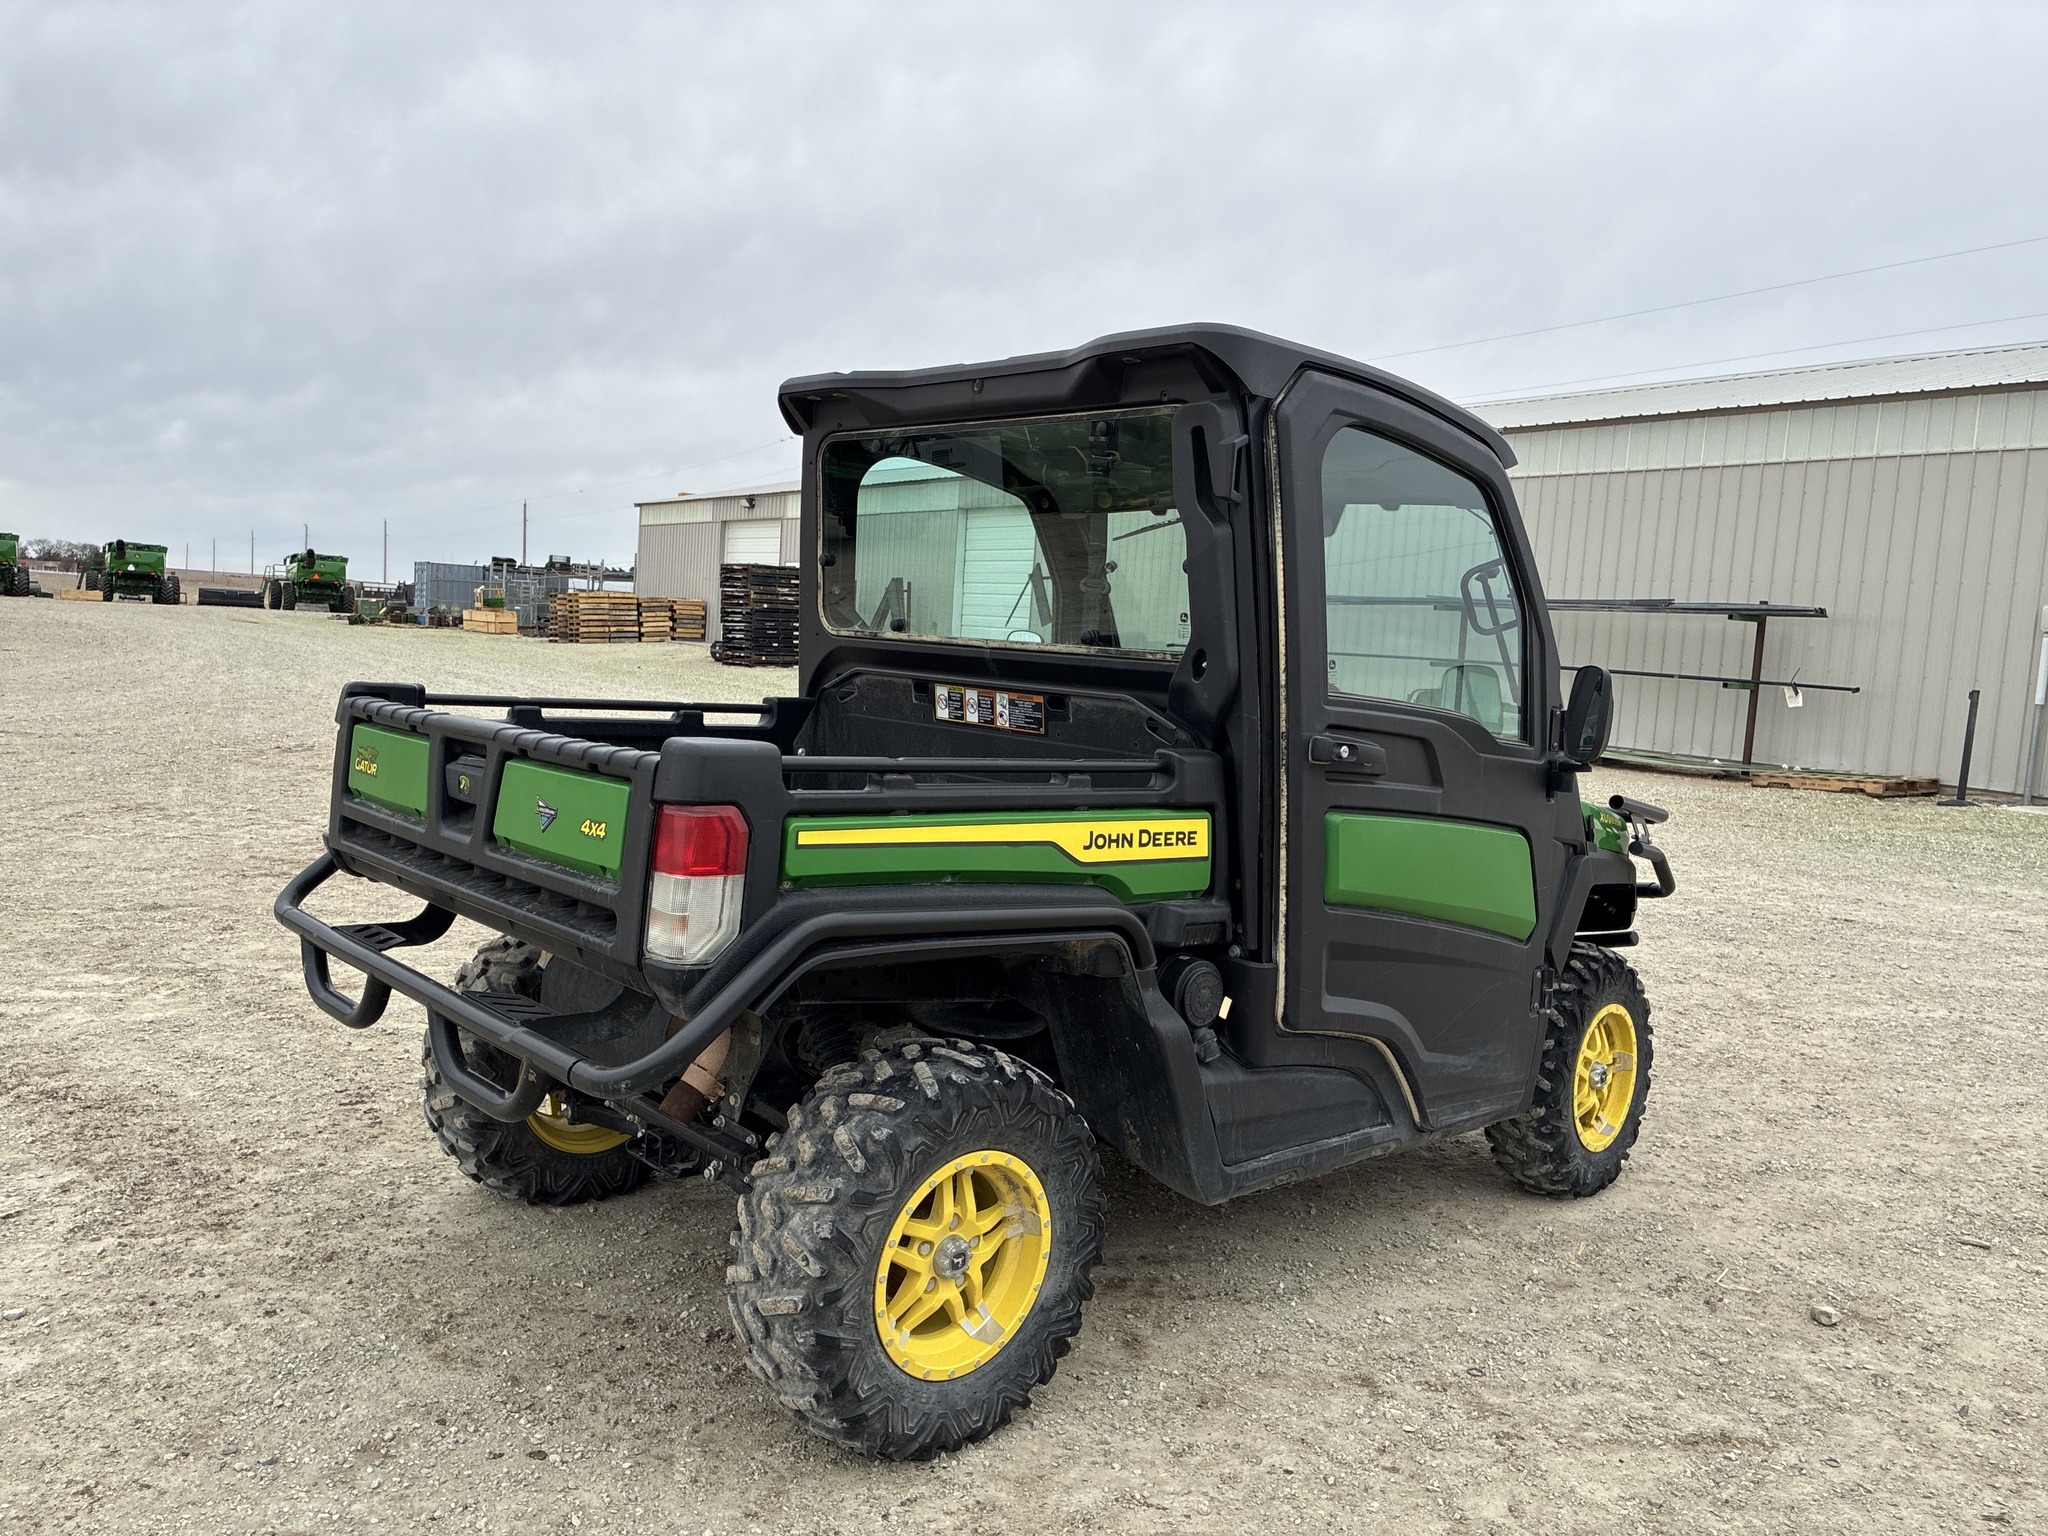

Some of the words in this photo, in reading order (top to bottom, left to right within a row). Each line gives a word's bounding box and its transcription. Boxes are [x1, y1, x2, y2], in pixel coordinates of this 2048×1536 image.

[355, 757, 378, 776] GATOR
[1083, 829, 1133, 850] JOHN
[1138, 829, 1197, 848] DEERE
